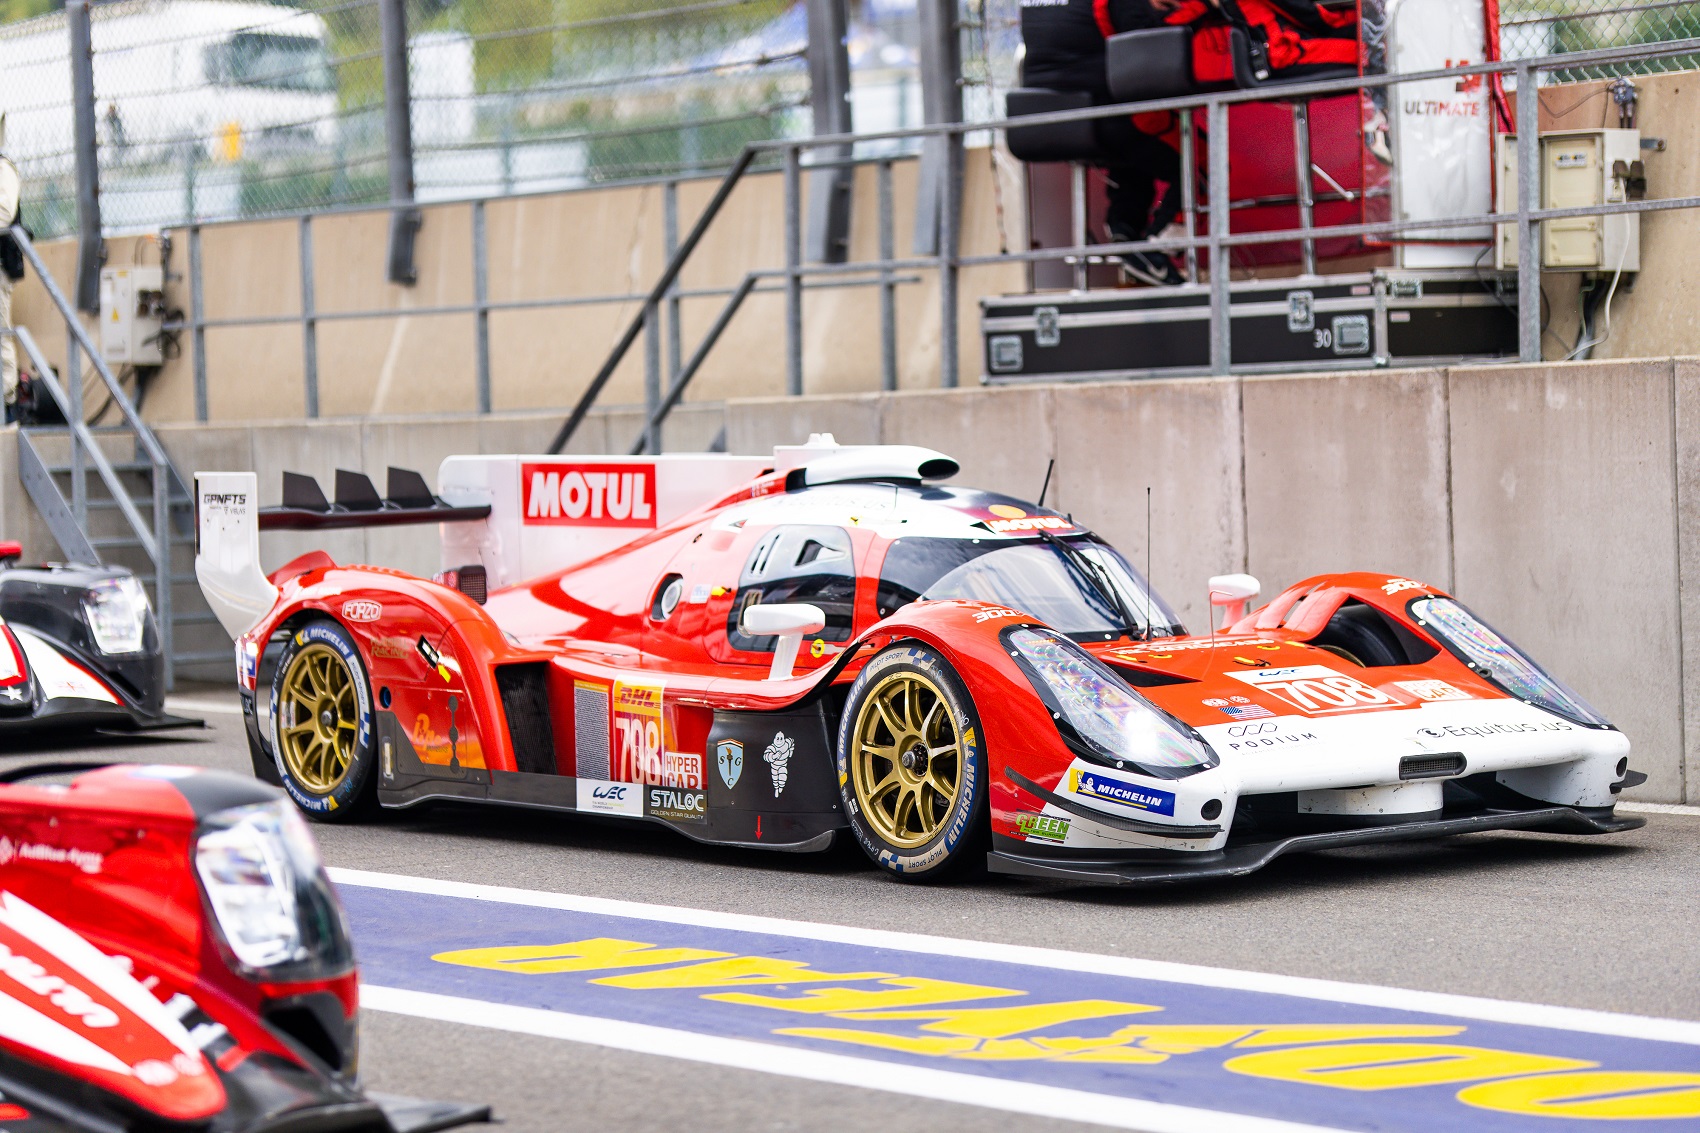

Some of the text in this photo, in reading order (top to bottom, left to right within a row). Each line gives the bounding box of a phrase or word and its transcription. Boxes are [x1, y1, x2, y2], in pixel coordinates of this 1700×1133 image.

[1405, 101, 1479, 117] ULTIMATE
[1313, 328, 1332, 349] 30
[203, 494, 247, 505] GPNFTS
[527, 471, 651, 520] MOTUL
[989, 517, 1073, 532] MOTUL
[344, 603, 379, 619] FORZO
[309, 627, 350, 656] MICHELIN
[370, 645, 408, 659] RACING
[870, 652, 904, 672] PILOT SPORT
[1259, 668, 1302, 677] WEC
[619, 687, 655, 708] DHL
[1265, 677, 1389, 709] 708
[838, 674, 864, 755] MICHELIN
[1443, 722, 1573, 738] Equitus.us
[1228, 732, 1318, 751] PODIUM
[615, 717, 663, 786] 708
[718, 755, 742, 767] S G
[666, 756, 699, 774] HYPER
[727, 777, 735, 786] C
[283, 778, 322, 811] MICHELIN
[592, 786, 627, 801] WEC
[650, 789, 704, 812] STALOC
[1097, 783, 1163, 807] MICHELIN
[650, 809, 670, 817] GOLDEN
[947, 763, 975, 846] MICHELIN
[1016, 814, 1070, 833] GREEN
[909, 848, 943, 869] PILOT SPORT
